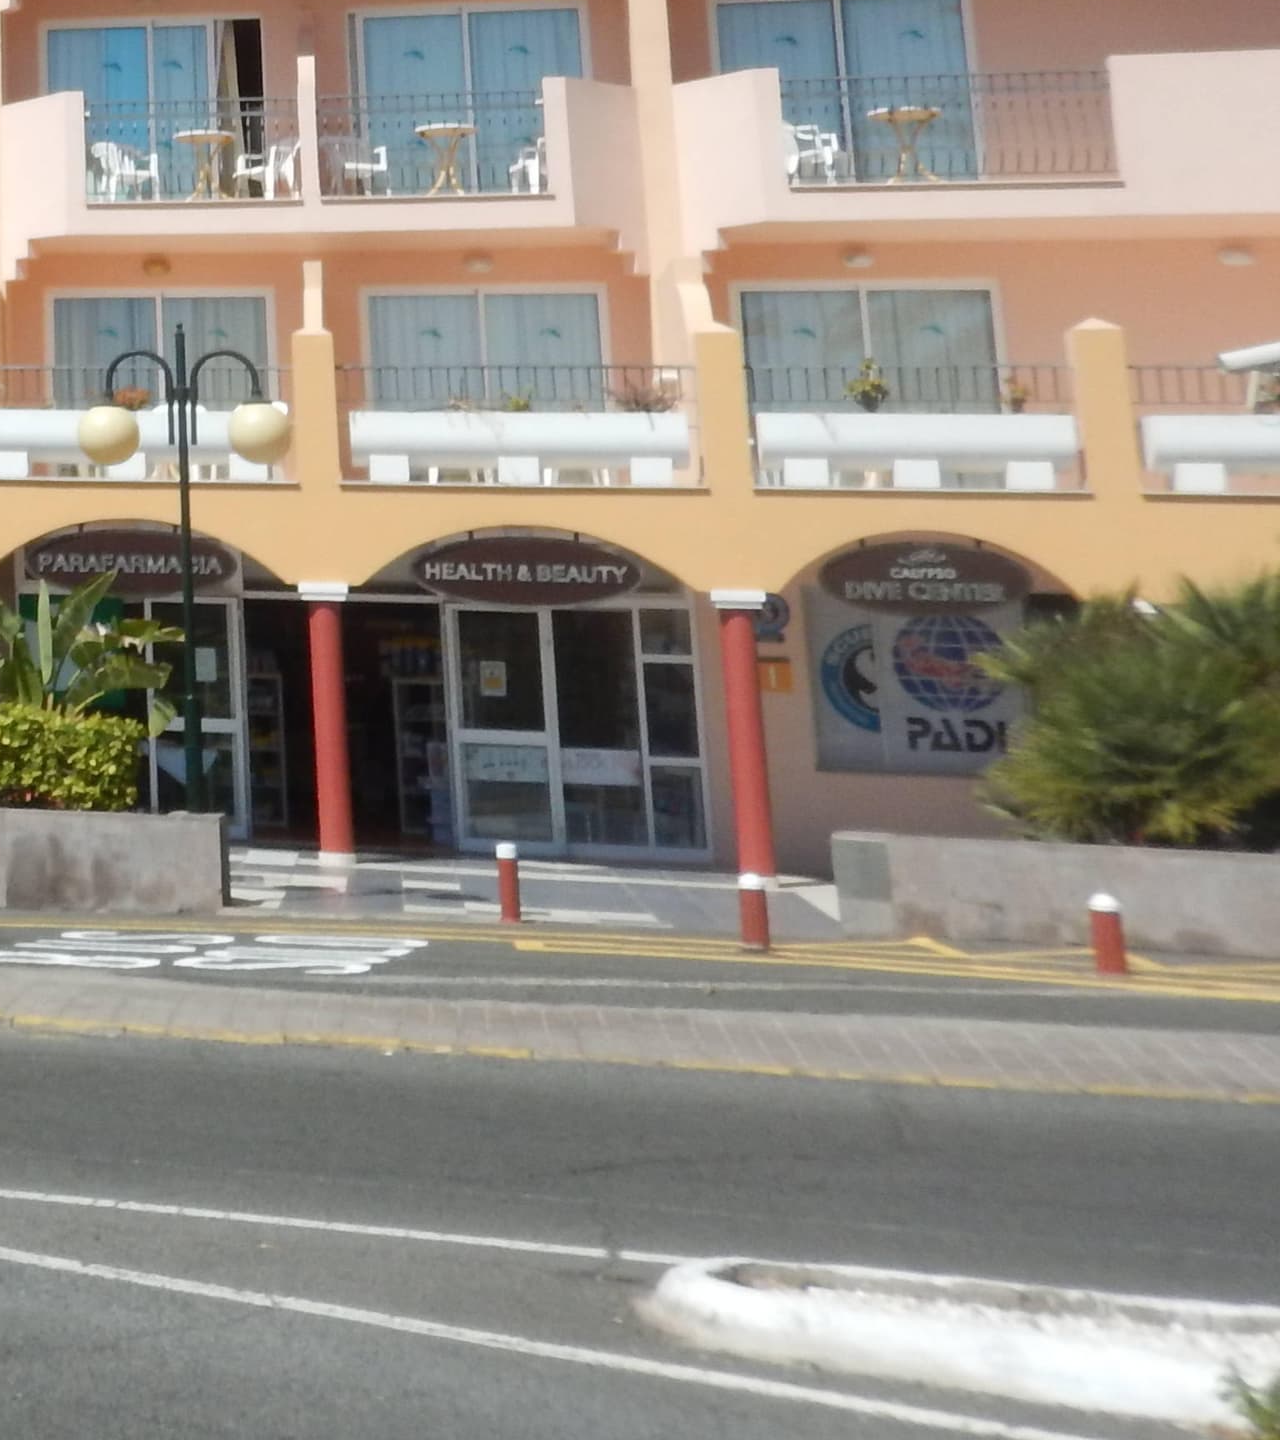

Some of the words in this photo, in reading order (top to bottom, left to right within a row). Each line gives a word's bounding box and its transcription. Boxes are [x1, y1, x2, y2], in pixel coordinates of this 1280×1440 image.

[424, 562, 513, 582] HEALTH
[516, 564, 532, 582] &
[537, 564, 629, 585] BEAUTY
[844, 580, 903, 601] DIVE
[907, 581, 1005, 603] CENTER
[906, 716, 1006, 754] PADI
